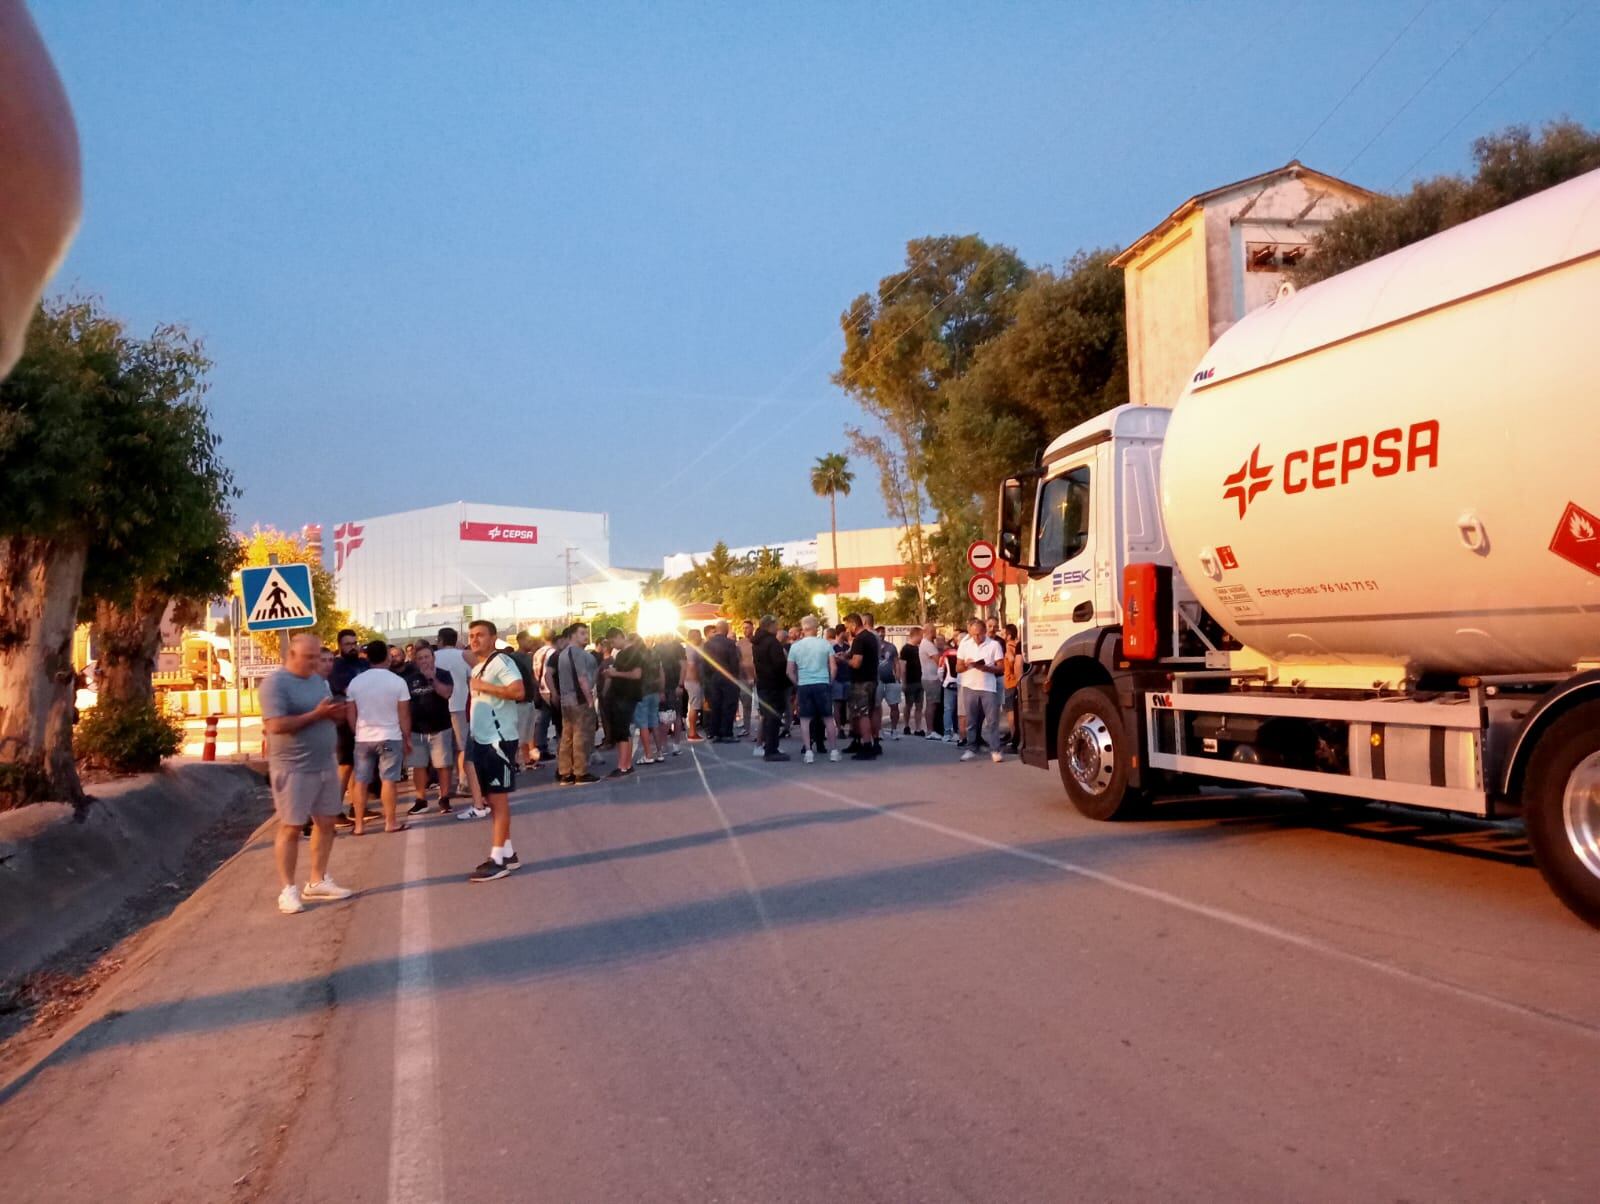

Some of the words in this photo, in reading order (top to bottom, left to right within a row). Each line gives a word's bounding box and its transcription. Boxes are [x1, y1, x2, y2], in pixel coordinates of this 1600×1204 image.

[1283, 419, 1440, 495] CEPSA
[502, 529, 533, 540] CEPSA
[1063, 569, 1091, 584] ESK
[977, 585, 990, 595] 30
